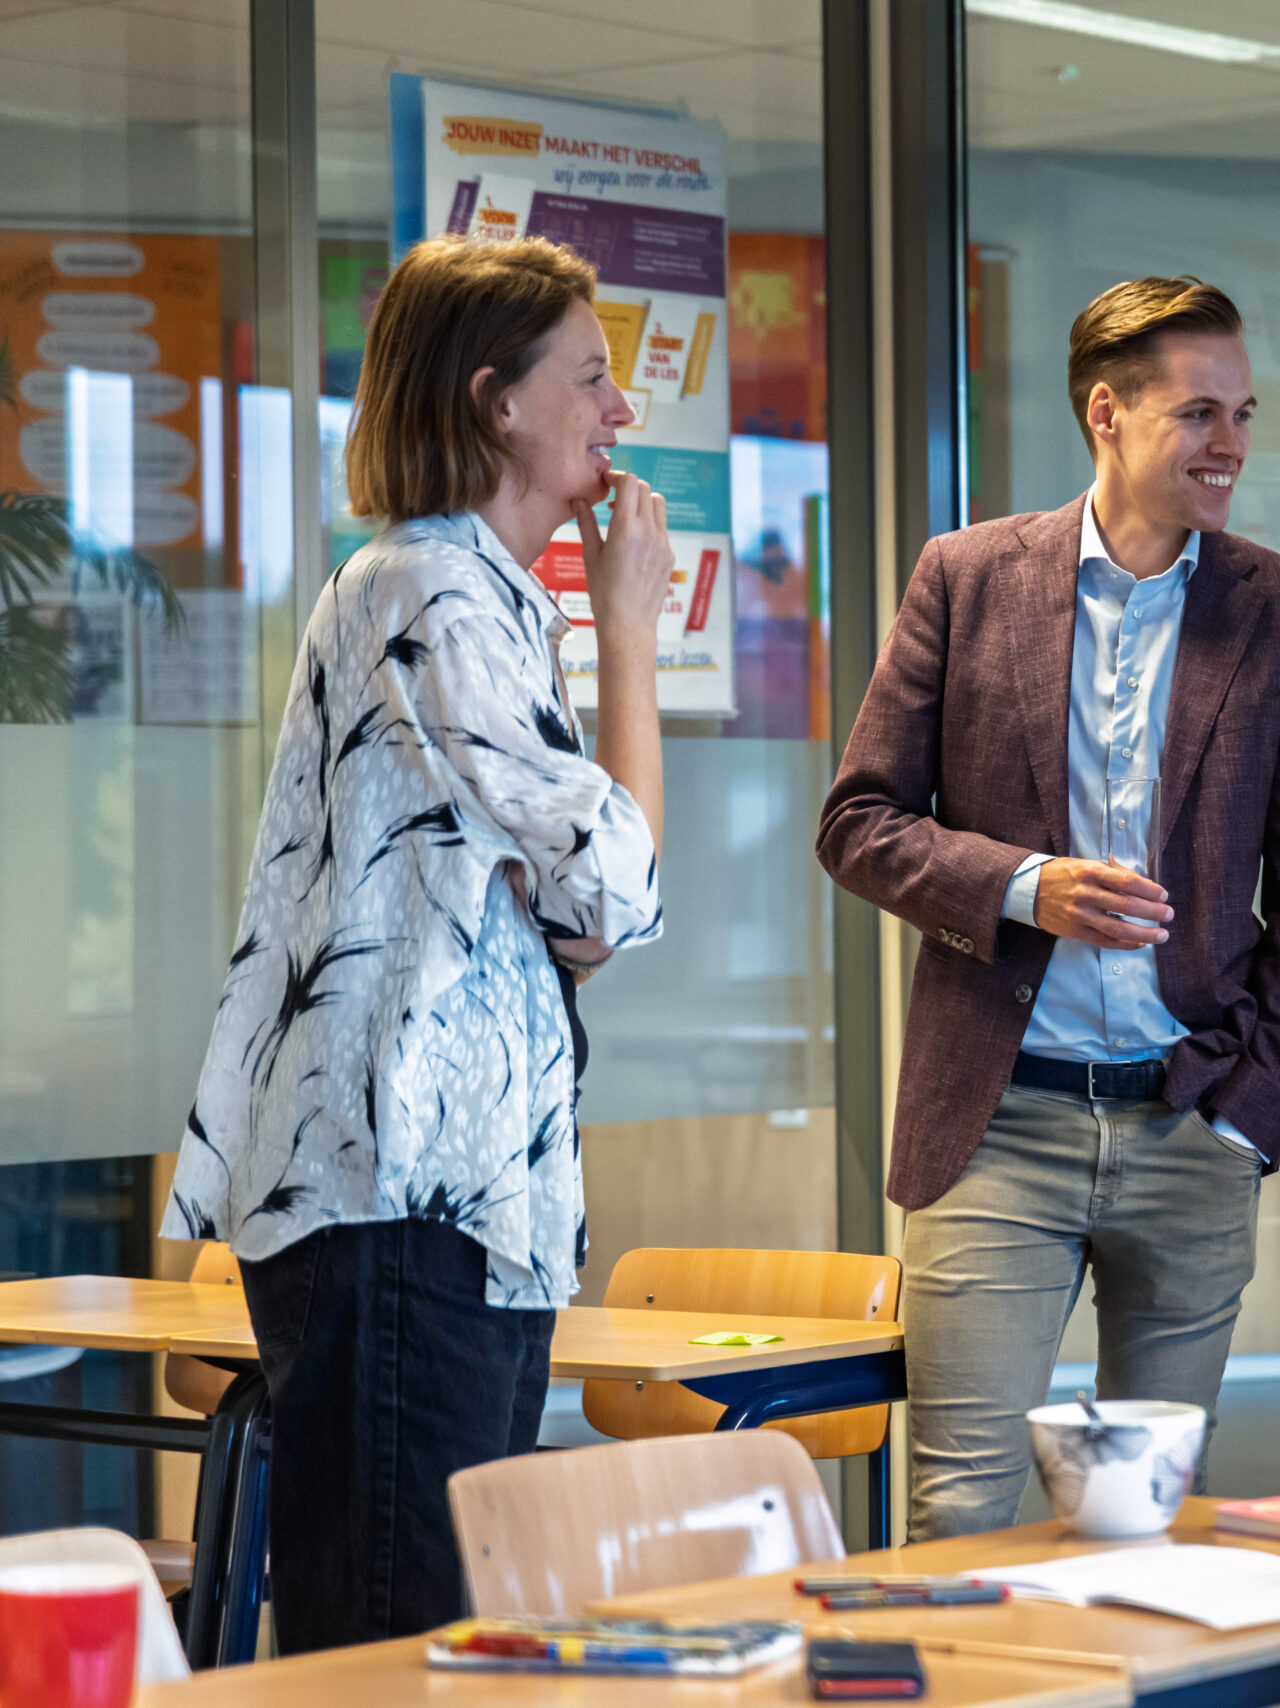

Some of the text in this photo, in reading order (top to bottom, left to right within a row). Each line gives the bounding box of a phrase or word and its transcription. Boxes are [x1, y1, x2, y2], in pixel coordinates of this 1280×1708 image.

[447, 121, 496, 144] JOUW
[498, 129, 541, 151] INZET
[545, 136, 600, 160] MAAKT
[603, 144, 630, 165] HET
[554, 163, 574, 193] wij
[578, 169, 621, 195] zorgen
[626, 173, 653, 187] voor
[655, 169, 673, 189] de
[648, 351, 670, 364] VAN
[645, 366, 680, 381] DE LES
